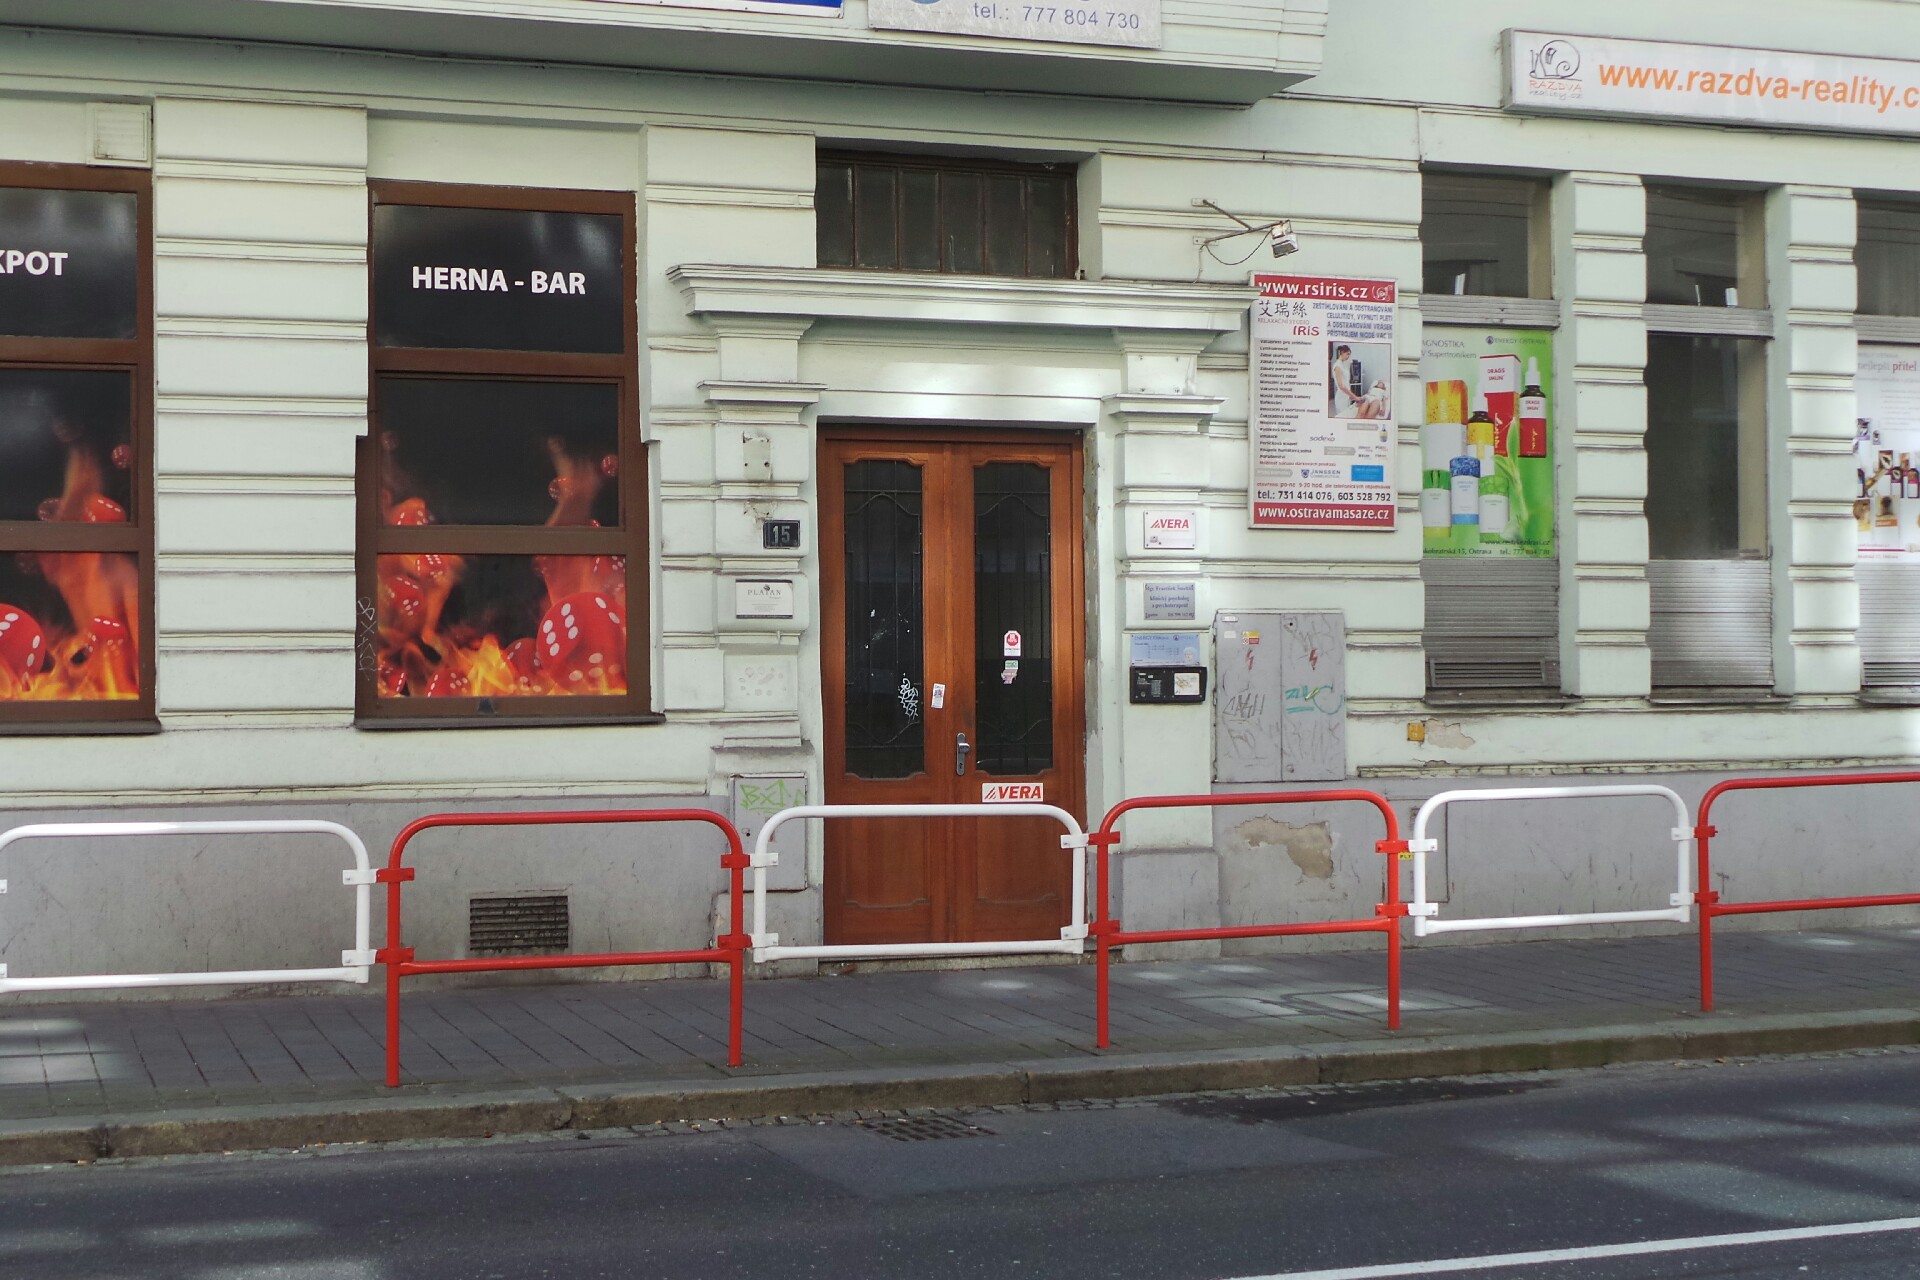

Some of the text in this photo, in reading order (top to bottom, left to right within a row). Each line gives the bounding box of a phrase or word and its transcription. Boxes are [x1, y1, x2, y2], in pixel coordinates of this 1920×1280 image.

[974, 2, 1140, 29] tel.: 777 804 730
[412, 266, 509, 292] HERNA
[531, 270, 586, 295] BAR
[1259, 281, 1368, 298] www.rsiris.cz
[1892, 360, 1917, 374] přítel
[1257, 490, 1391, 502] tel.: 731 414 076, 603 528 792
[1258, 507, 1390, 520] www.ostravamasaze.cz
[1159, 518, 1189, 529] VERA
[772, 525, 790, 545] 15
[998, 785, 1042, 799] VERA
